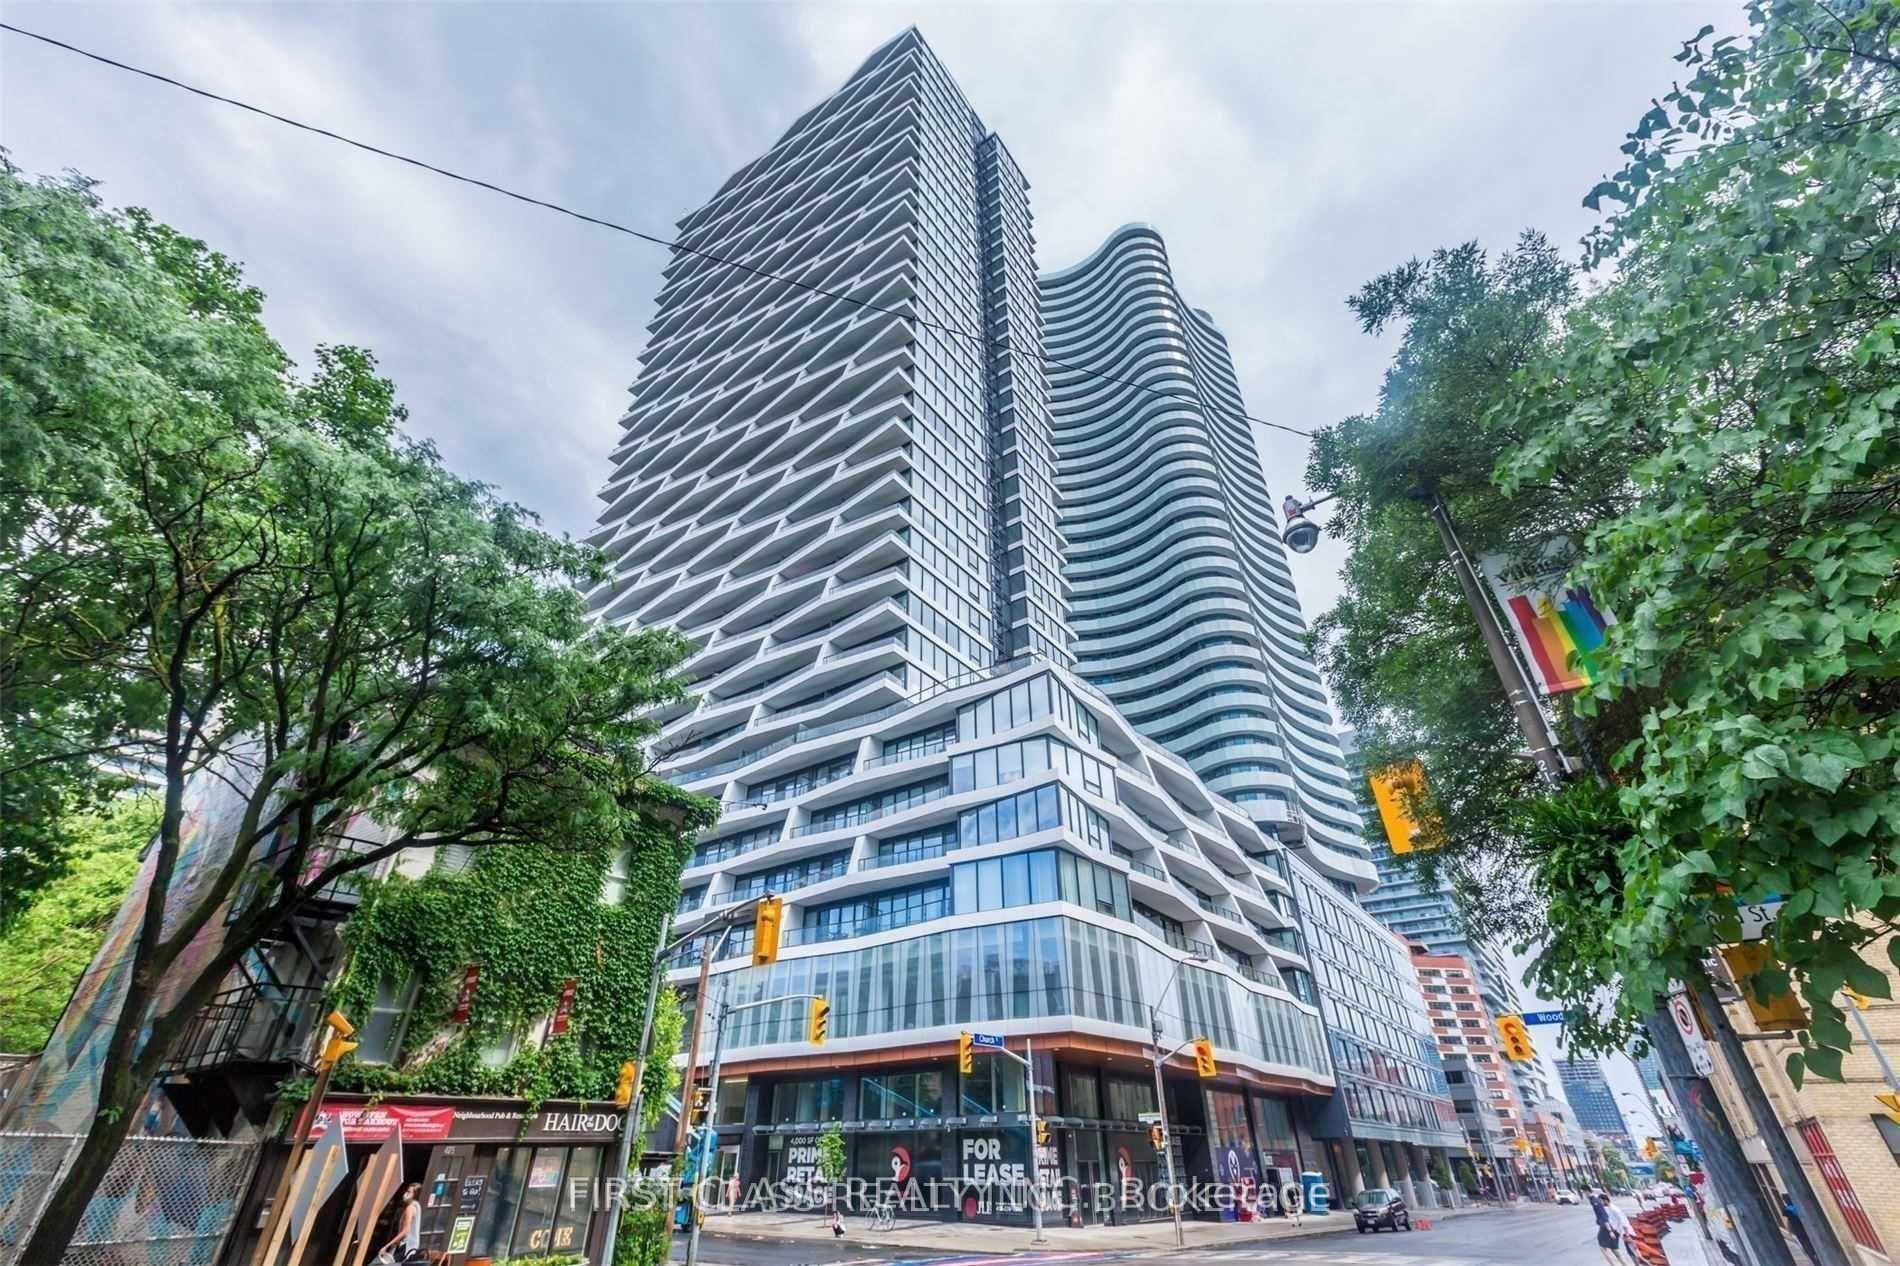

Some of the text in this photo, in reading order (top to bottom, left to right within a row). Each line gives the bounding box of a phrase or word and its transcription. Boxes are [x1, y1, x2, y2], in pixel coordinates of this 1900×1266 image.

[1747, 905, 1777, 922] St.
[1699, 958, 1719, 967] TIC
[544, 1113, 588, 1131] HAIR
[788, 1147, 823, 1163] PRIM
[963, 1139, 1001, 1160] FOR
[1037, 1147, 1058, 1165] RIME
[787, 1166, 828, 1183] RETA
[963, 1163, 1024, 1186] LEASE
[1039, 1168, 1062, 1187] ETAIL
